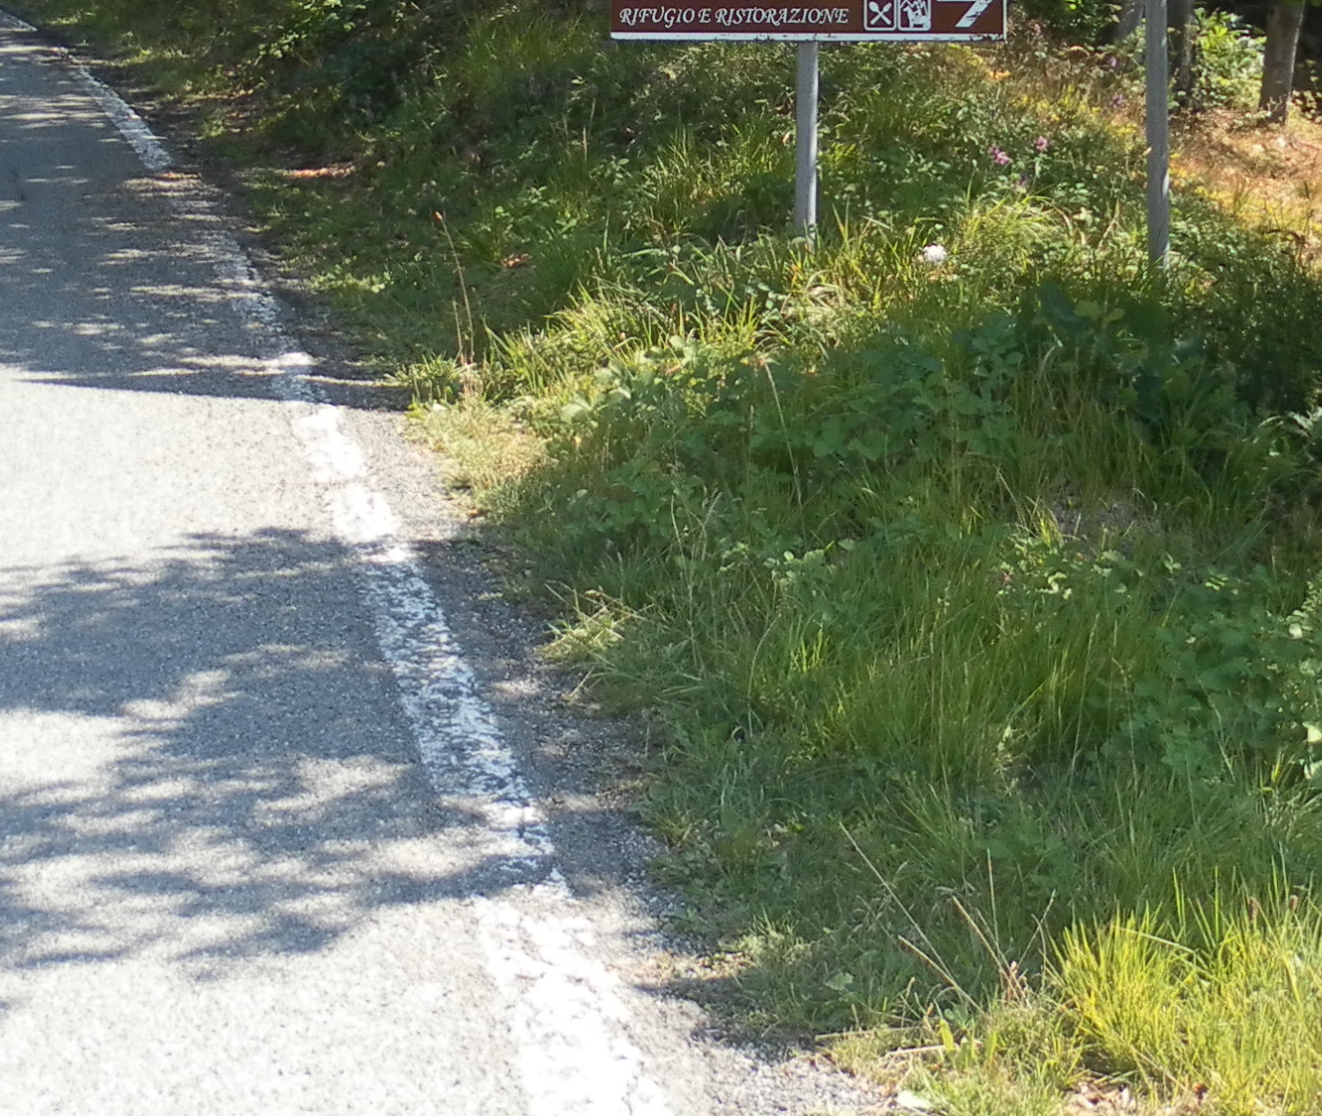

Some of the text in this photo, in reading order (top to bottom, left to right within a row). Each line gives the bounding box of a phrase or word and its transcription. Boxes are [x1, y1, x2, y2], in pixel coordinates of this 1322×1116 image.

[619, 7, 849, 28] RIFUGIO E RISTORAZIONE
